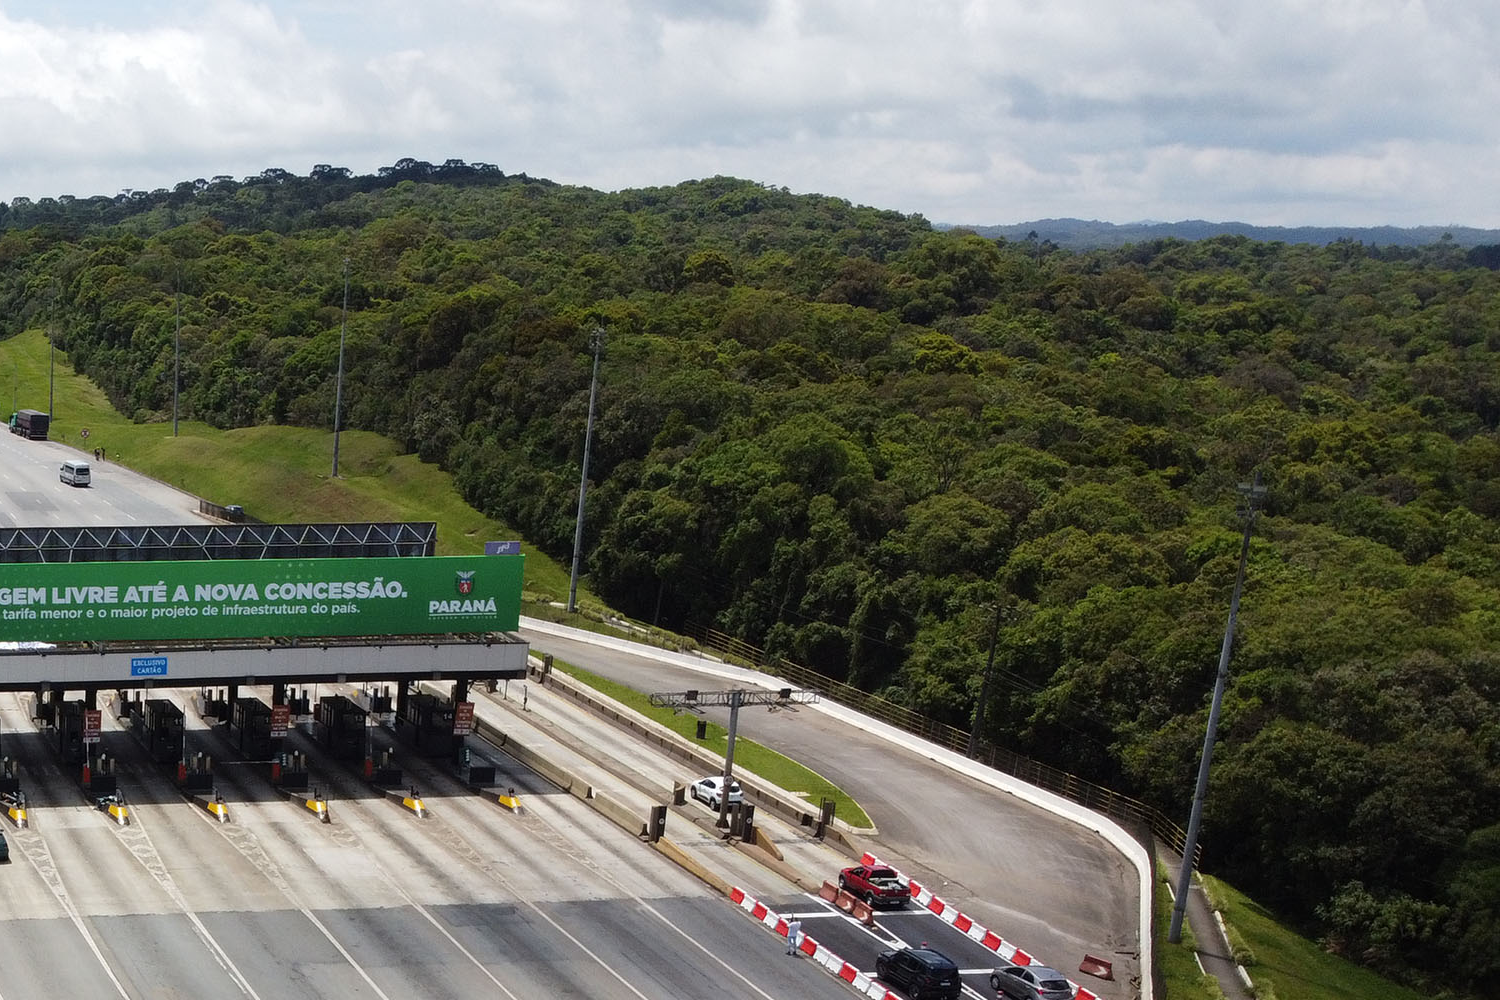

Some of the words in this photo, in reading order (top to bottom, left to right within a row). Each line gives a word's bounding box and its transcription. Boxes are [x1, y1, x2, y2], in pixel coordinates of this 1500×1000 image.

[52, 586, 118, 605] LIVRE
[123, 580, 167, 603] ATÉ
[171, 584, 190, 602] A
[194, 583, 260, 602] NOVA
[264, 577, 408, 601] CONCESSÃO.
[2, 608, 37, 620] tarifa
[40, 609, 83, 620] menor
[86, 609, 94, 618] e
[98, 609, 107, 618] o
[110, 607, 148, 618] maior
[151, 604, 198, 619] projeto
[202, 604, 219, 616] de
[222, 603, 307, 616] infraestrutura
[310, 602, 328, 614] do
[331, 601, 360, 616] país.
[429, 597, 497, 613] PARANÁ
[137, 666, 162, 674] CARTÃO
